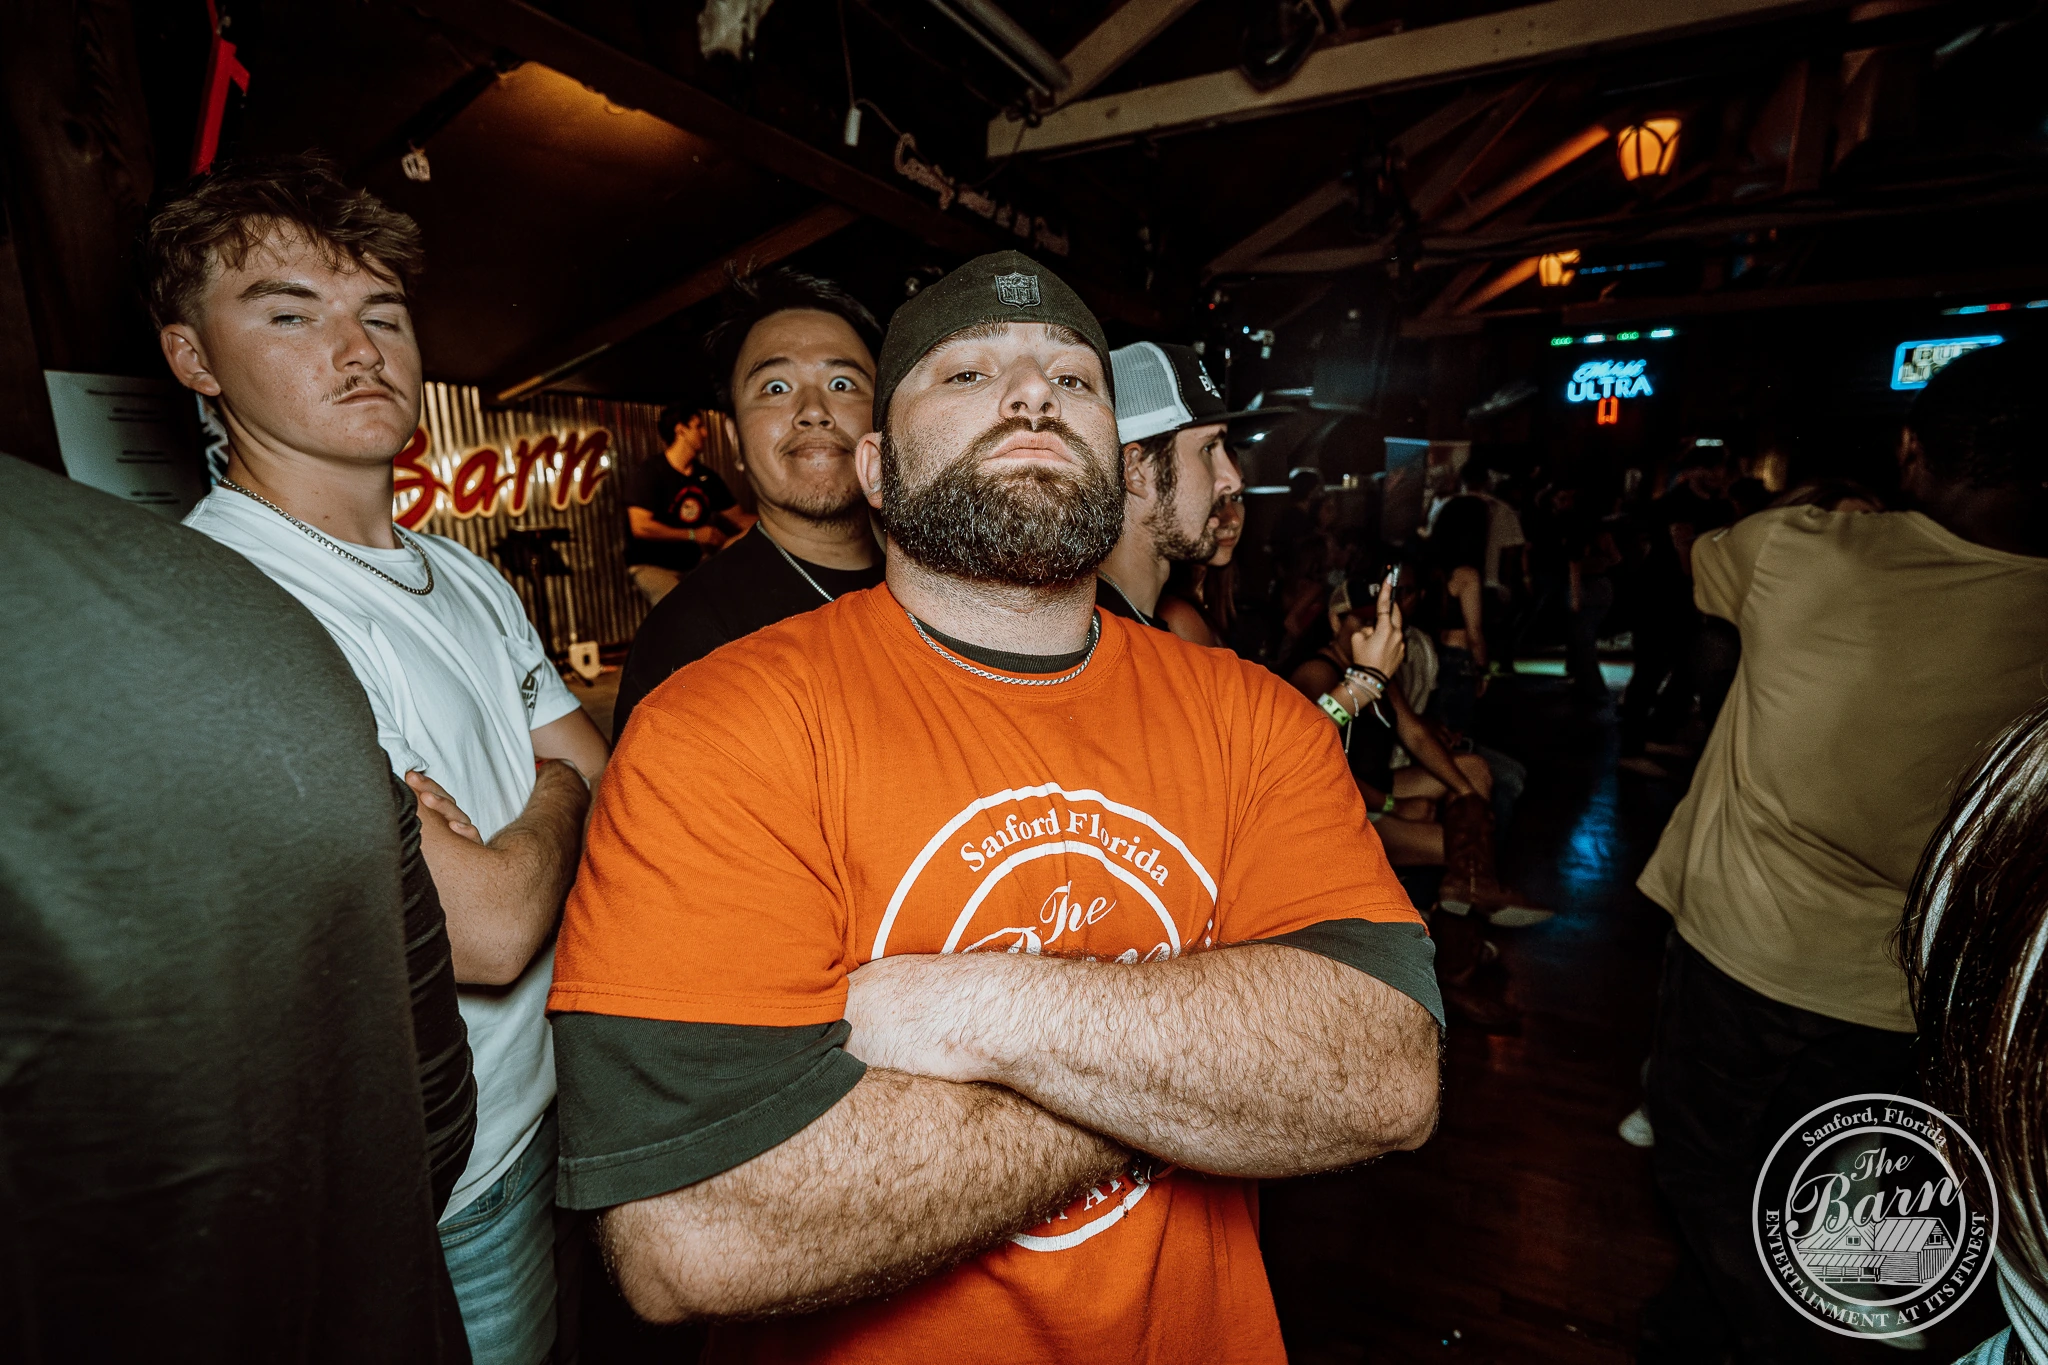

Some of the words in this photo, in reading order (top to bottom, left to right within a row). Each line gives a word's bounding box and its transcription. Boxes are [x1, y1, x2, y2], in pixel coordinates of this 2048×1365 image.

[1567, 374, 1654, 402] ULTRA
[960, 807, 1060, 873] Sanford
[1065, 810, 1169, 887] Florida
[1040, 880, 1116, 945] The
